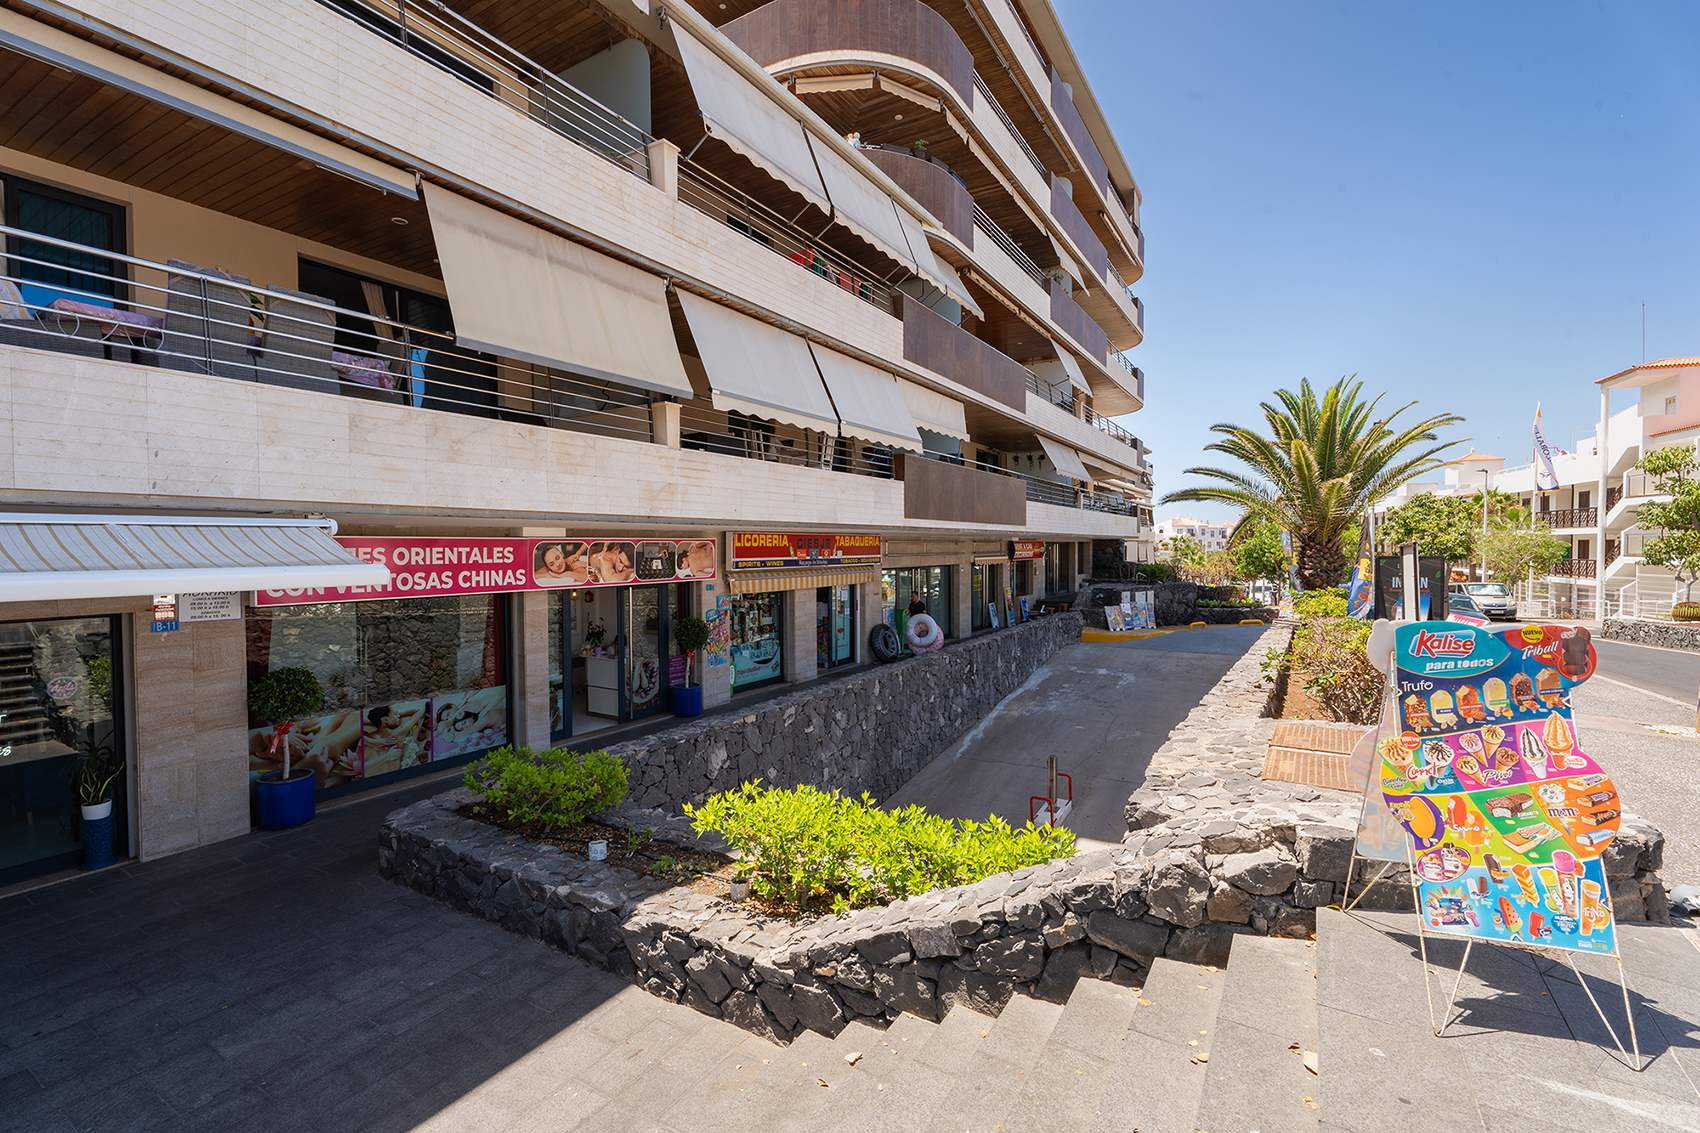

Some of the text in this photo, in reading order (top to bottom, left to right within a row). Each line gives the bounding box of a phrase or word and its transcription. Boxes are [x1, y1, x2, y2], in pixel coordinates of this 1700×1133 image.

[735, 534, 789, 547] LICORERIA
[797, 538, 831, 549] CIESJE
[392, 547, 514, 566] ORIENTALES
[458, 569, 527, 588] CHINAS
[156, 621, 176, 632] B-11
[1415, 630, 1475, 657] Kalise
[1521, 641, 1559, 660] Triball
[1426, 658, 1494, 671] para todos
[1402, 680, 1433, 692] Trufo
